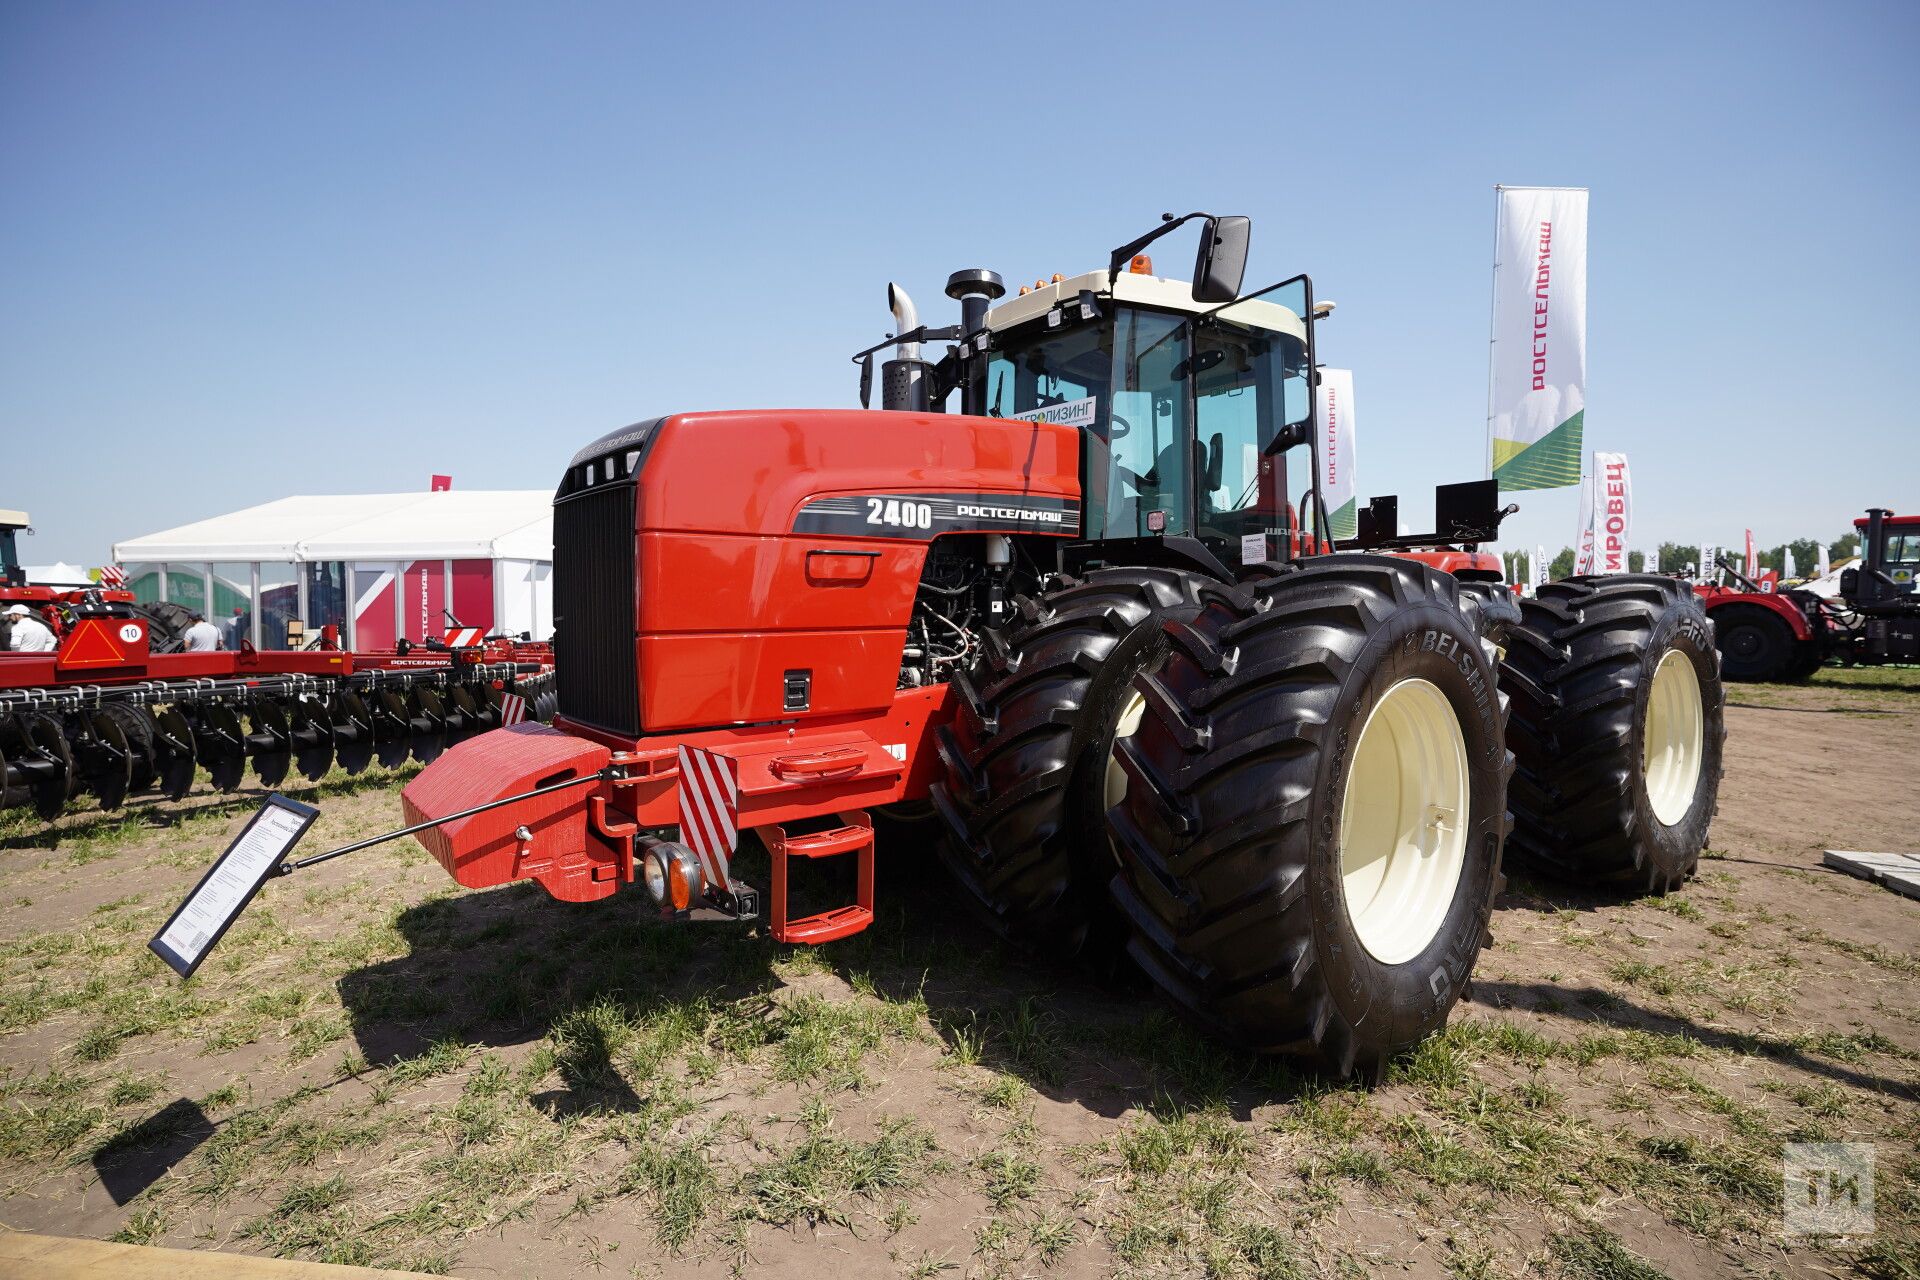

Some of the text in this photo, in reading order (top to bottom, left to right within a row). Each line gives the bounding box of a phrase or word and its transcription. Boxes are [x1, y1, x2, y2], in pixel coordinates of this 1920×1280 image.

[1532, 221, 1552, 391] РОСТСЕЛЬМАШ
[1327, 387, 1337, 485] РОСТСЕЛЬМАШ
[866, 498, 932, 529] 2400
[957, 505, 1062, 522] РОСТСЕЛЬМАШ
[125, 628, 137, 638] 10
[1420, 630, 1500, 763] BELSHINA
